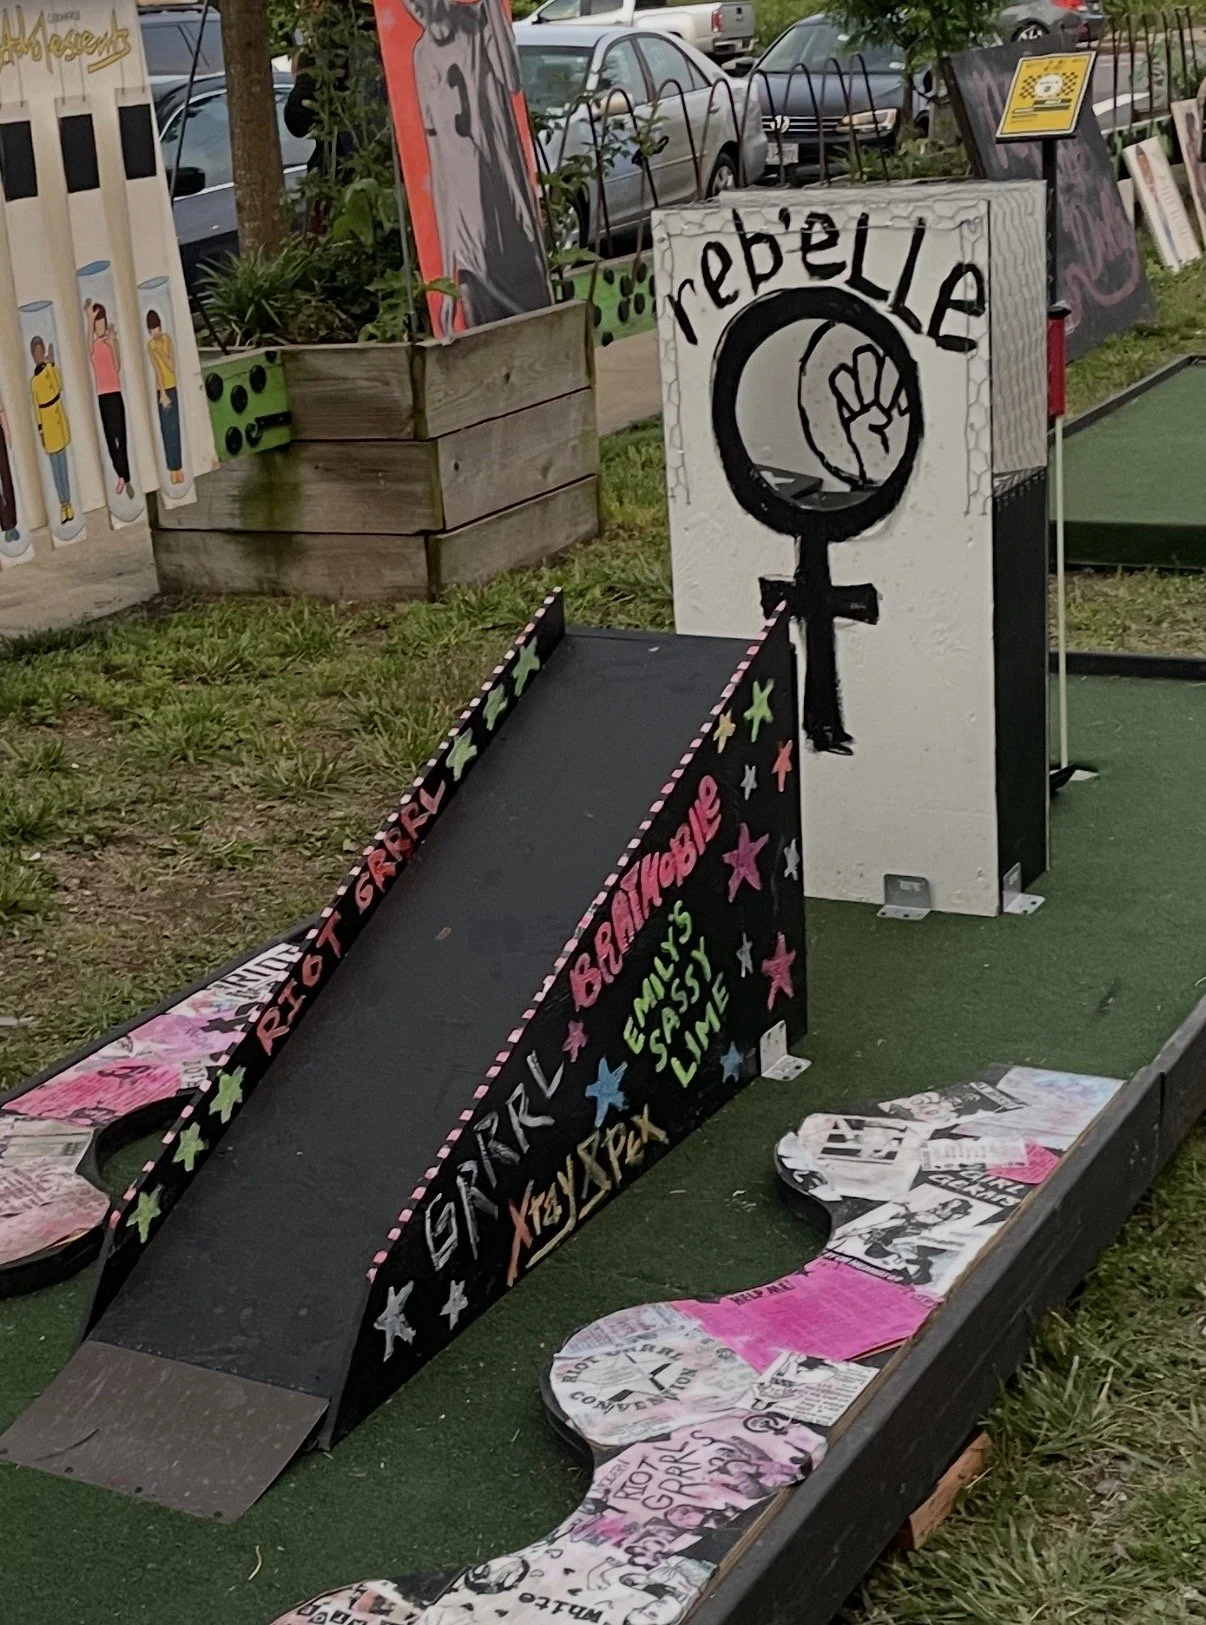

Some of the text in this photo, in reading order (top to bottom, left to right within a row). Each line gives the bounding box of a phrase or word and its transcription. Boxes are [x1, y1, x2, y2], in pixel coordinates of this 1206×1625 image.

[256, 779, 446, 1056] RIOT GRRRL
[623, 900, 692, 1054] EMILY'S
[650, 936, 712, 1072] SASSY
[671, 972, 730, 1088] LIME
[729, 1285, 765, 1306] HELP
[613, 1453, 657, 1501] RIOT
